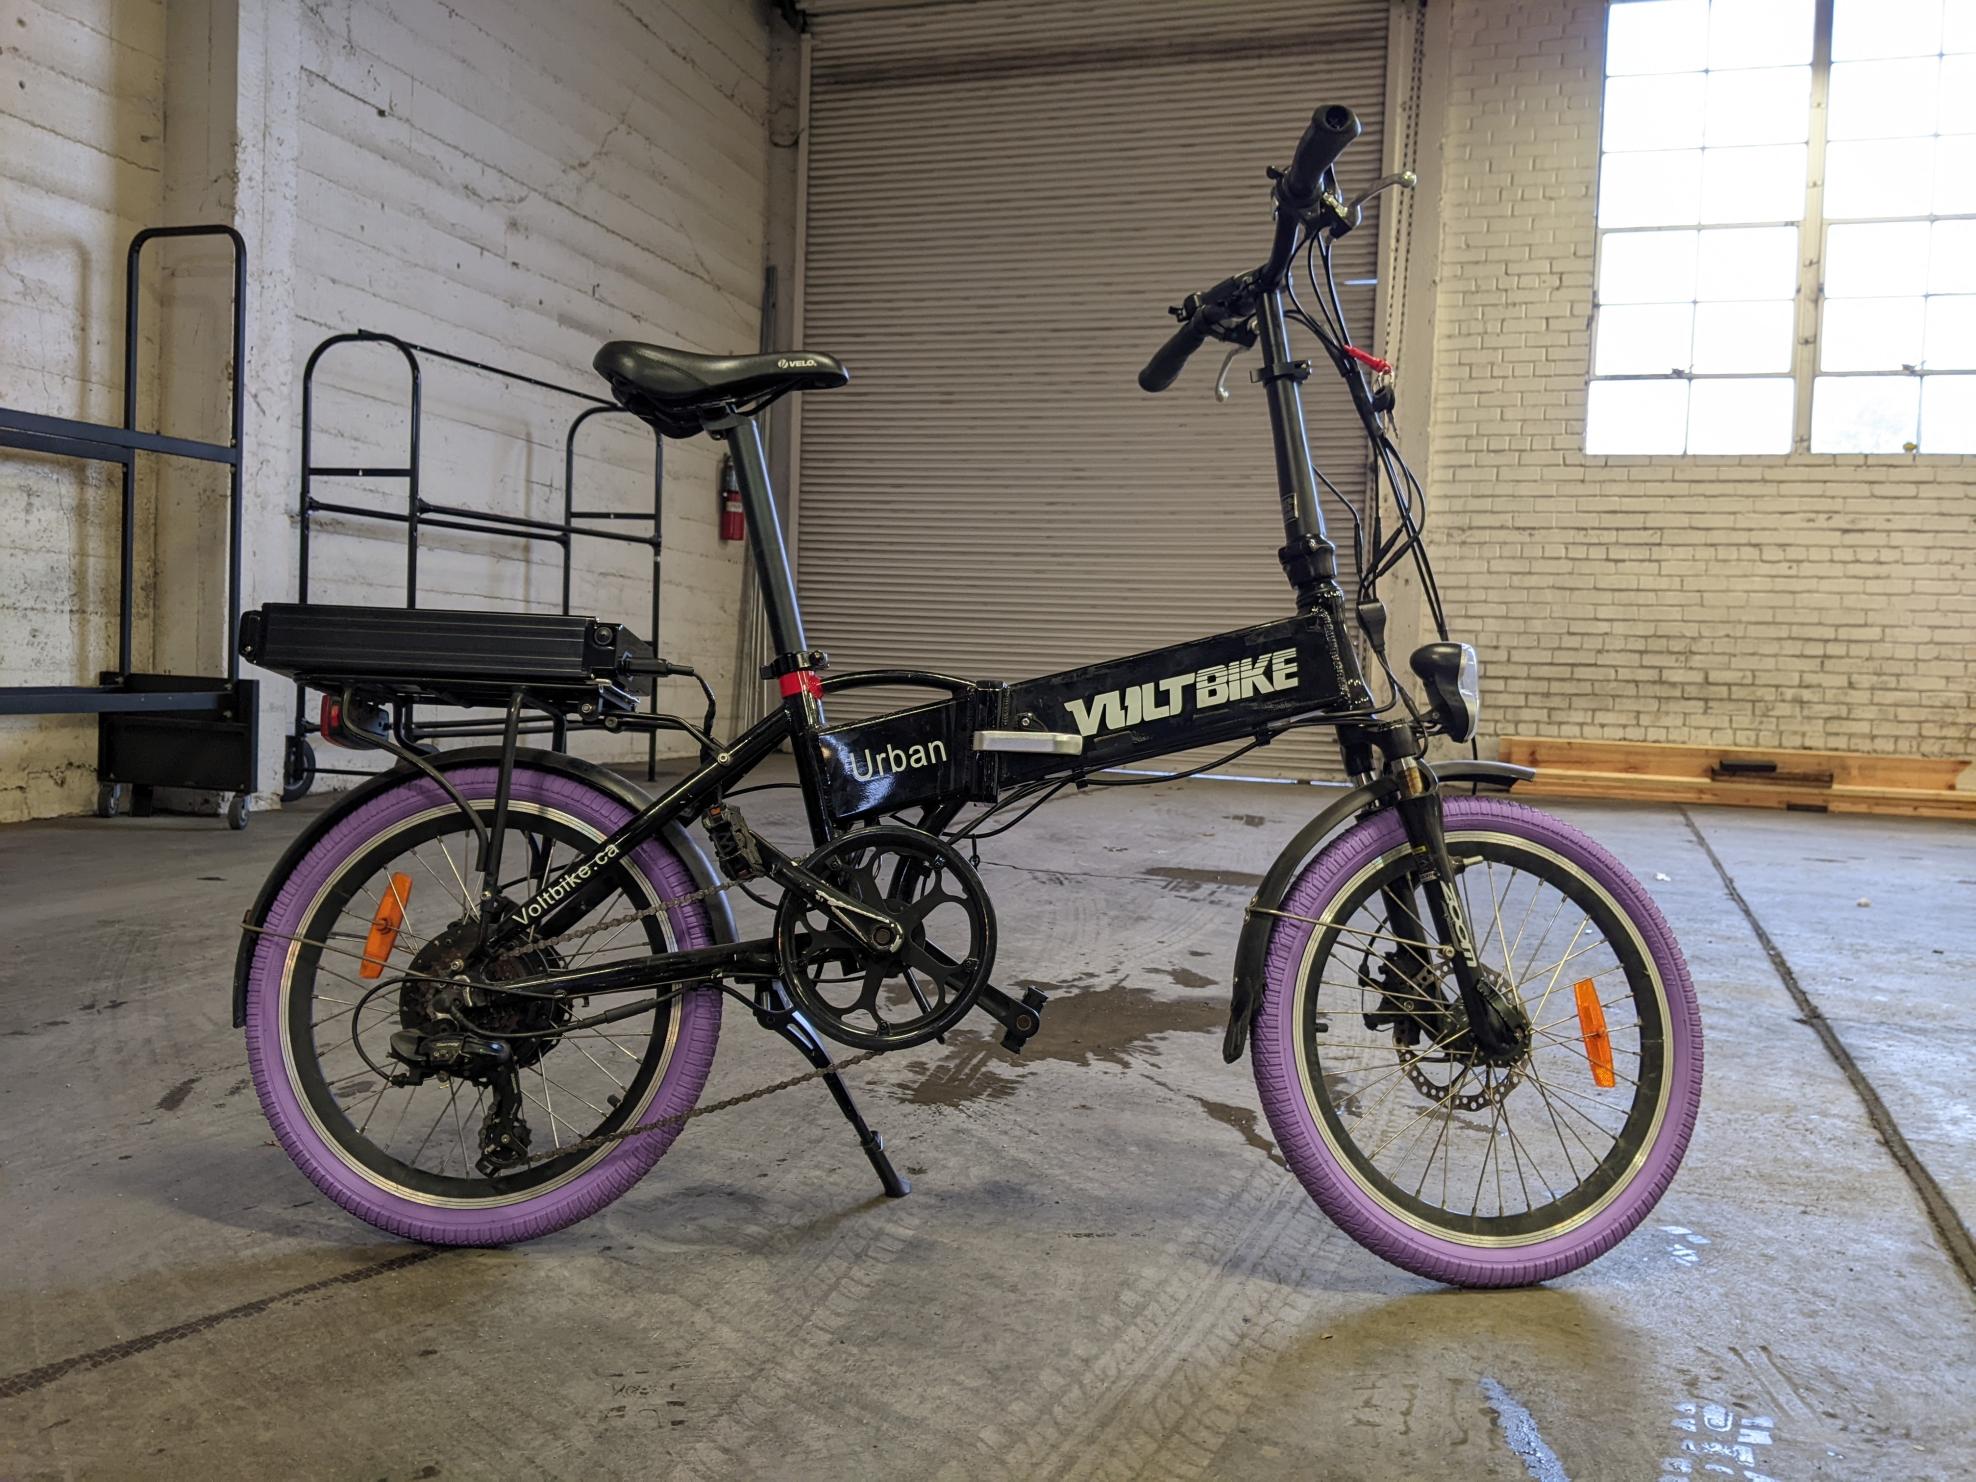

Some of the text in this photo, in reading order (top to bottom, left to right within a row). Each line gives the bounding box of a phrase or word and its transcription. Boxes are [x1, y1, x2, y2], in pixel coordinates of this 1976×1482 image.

[789, 359, 815, 367] VELO
[849, 740, 947, 782] Urban
[512, 844, 619, 925] Voltbike.ca
